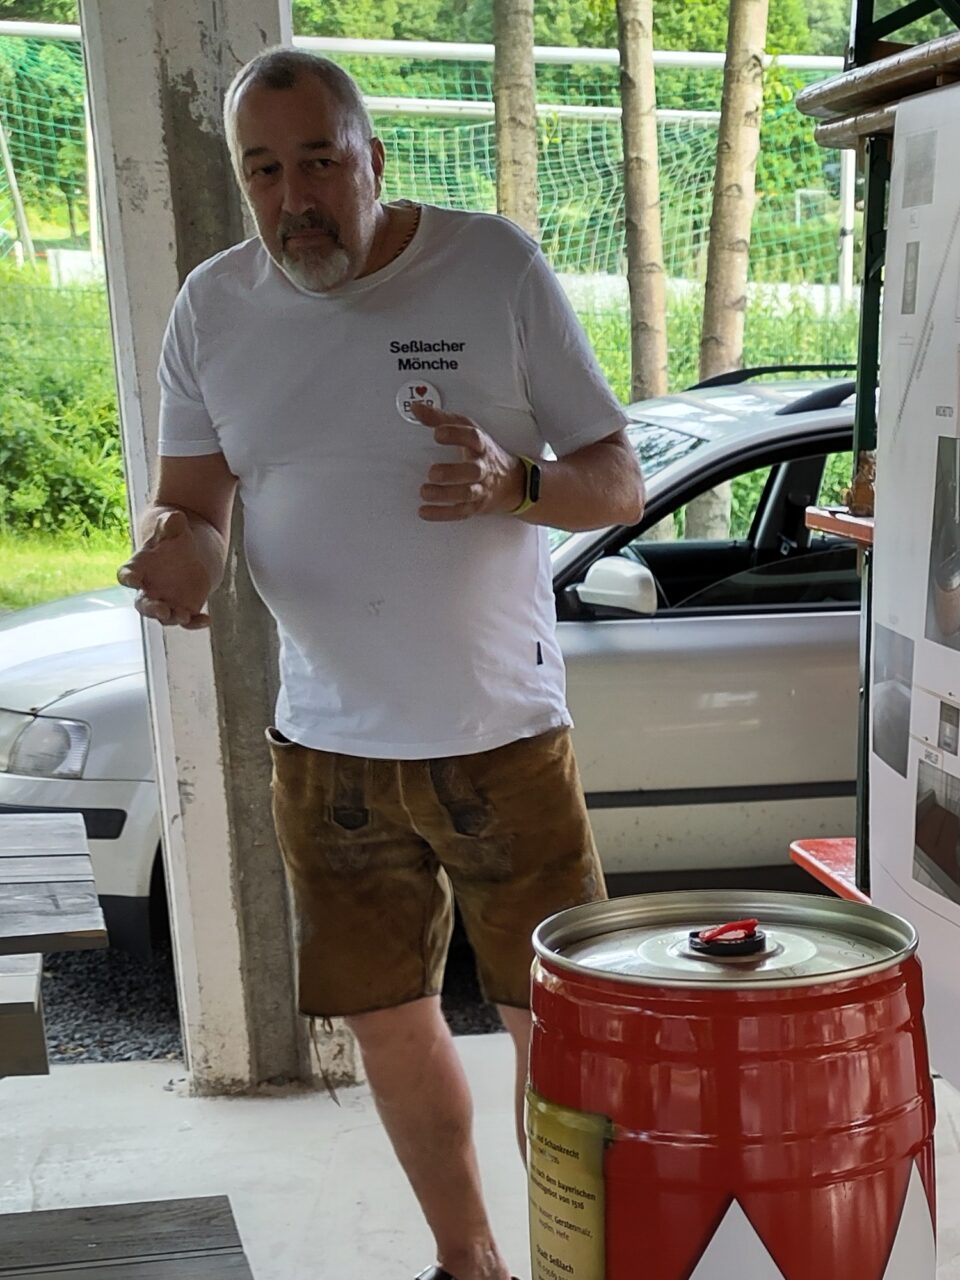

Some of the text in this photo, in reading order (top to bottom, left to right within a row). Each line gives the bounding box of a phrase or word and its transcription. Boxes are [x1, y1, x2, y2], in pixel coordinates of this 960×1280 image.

[390, 340, 466, 353] Seßlacher
[398, 357, 458, 371] Mönche
[408, 386, 416, 400] I
[558, 1181, 596, 1200] bayerischen
[559, 1195, 570, 1204] von
[550, 1255, 573, 1274] Seßlach
